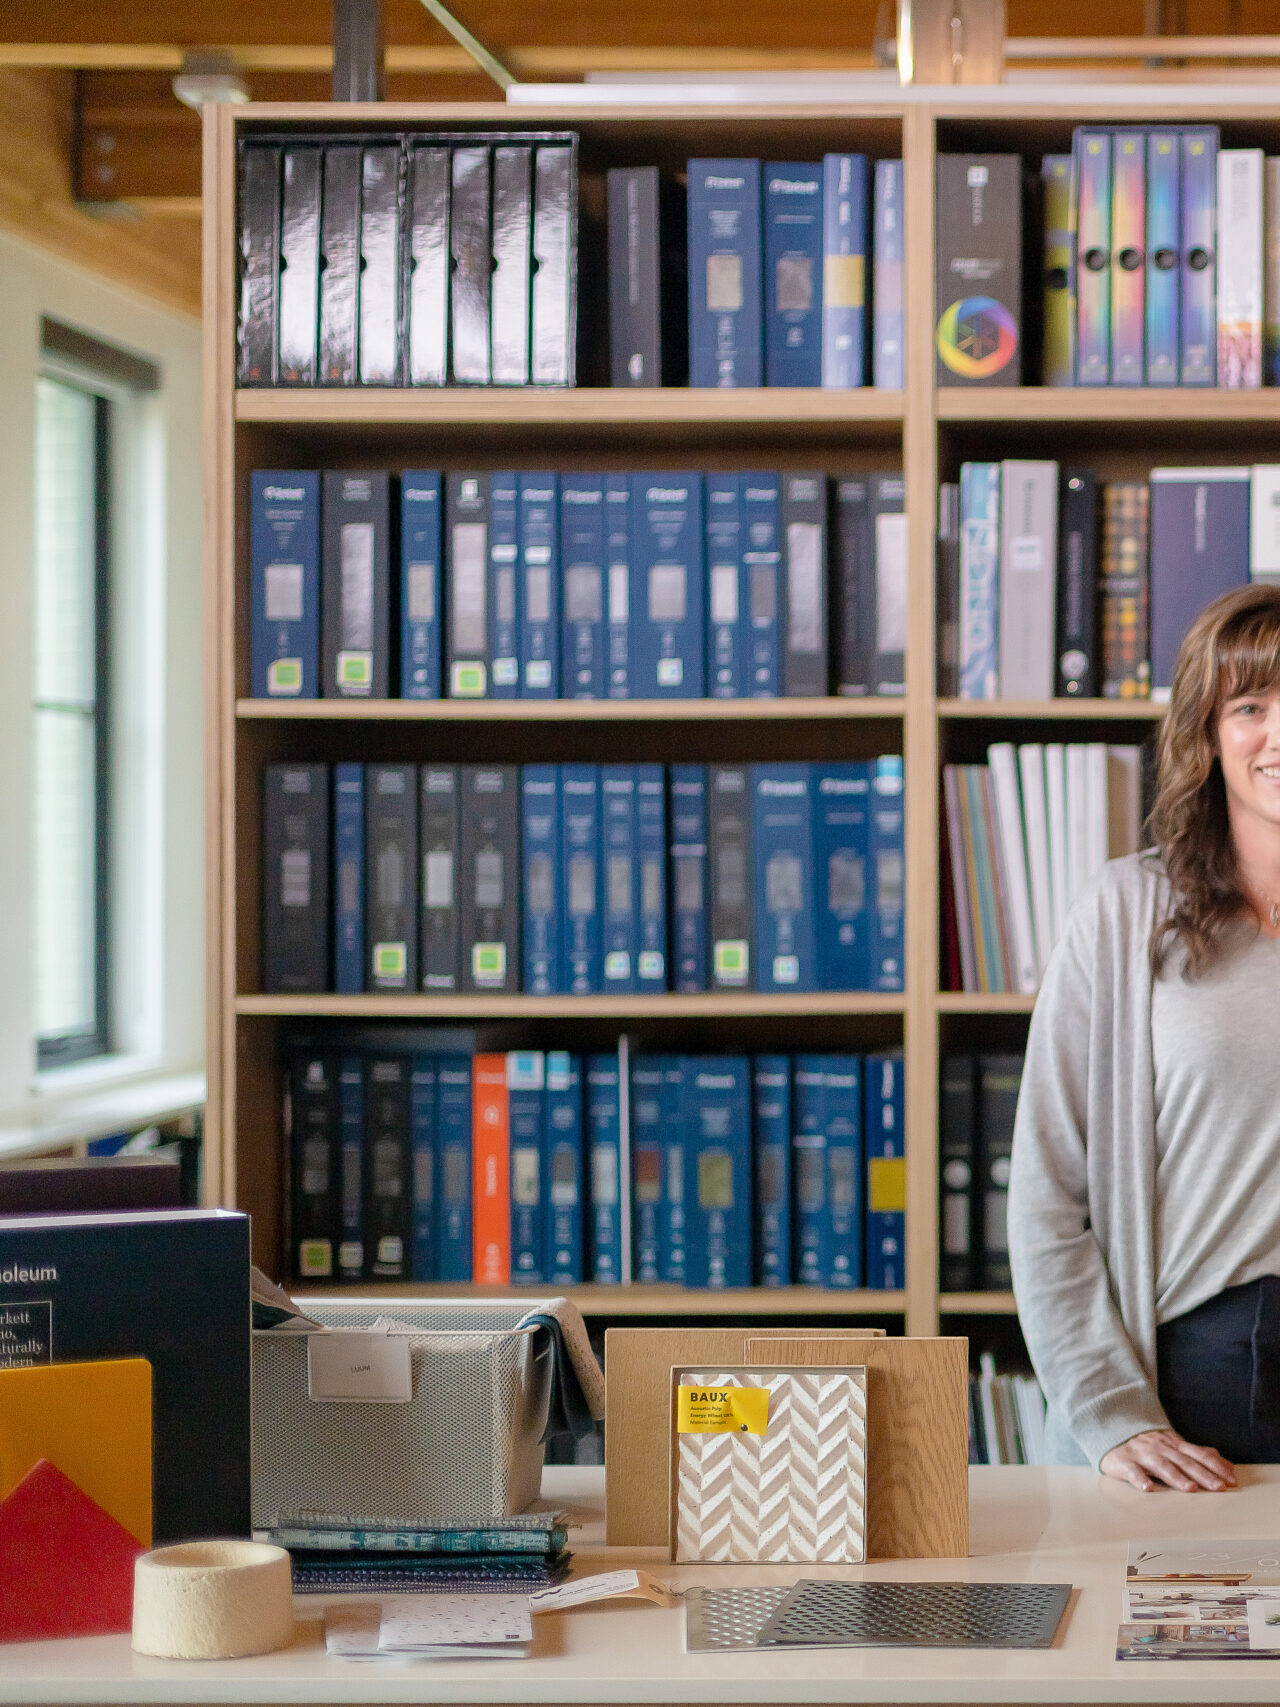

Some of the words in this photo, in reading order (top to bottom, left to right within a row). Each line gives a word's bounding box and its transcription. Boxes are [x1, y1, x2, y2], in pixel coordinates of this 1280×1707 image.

[0, 1263, 57, 1283] oleum
[690, 1392, 728, 1402] BAUX
[1187, 1551, 1232, 1561] 23
